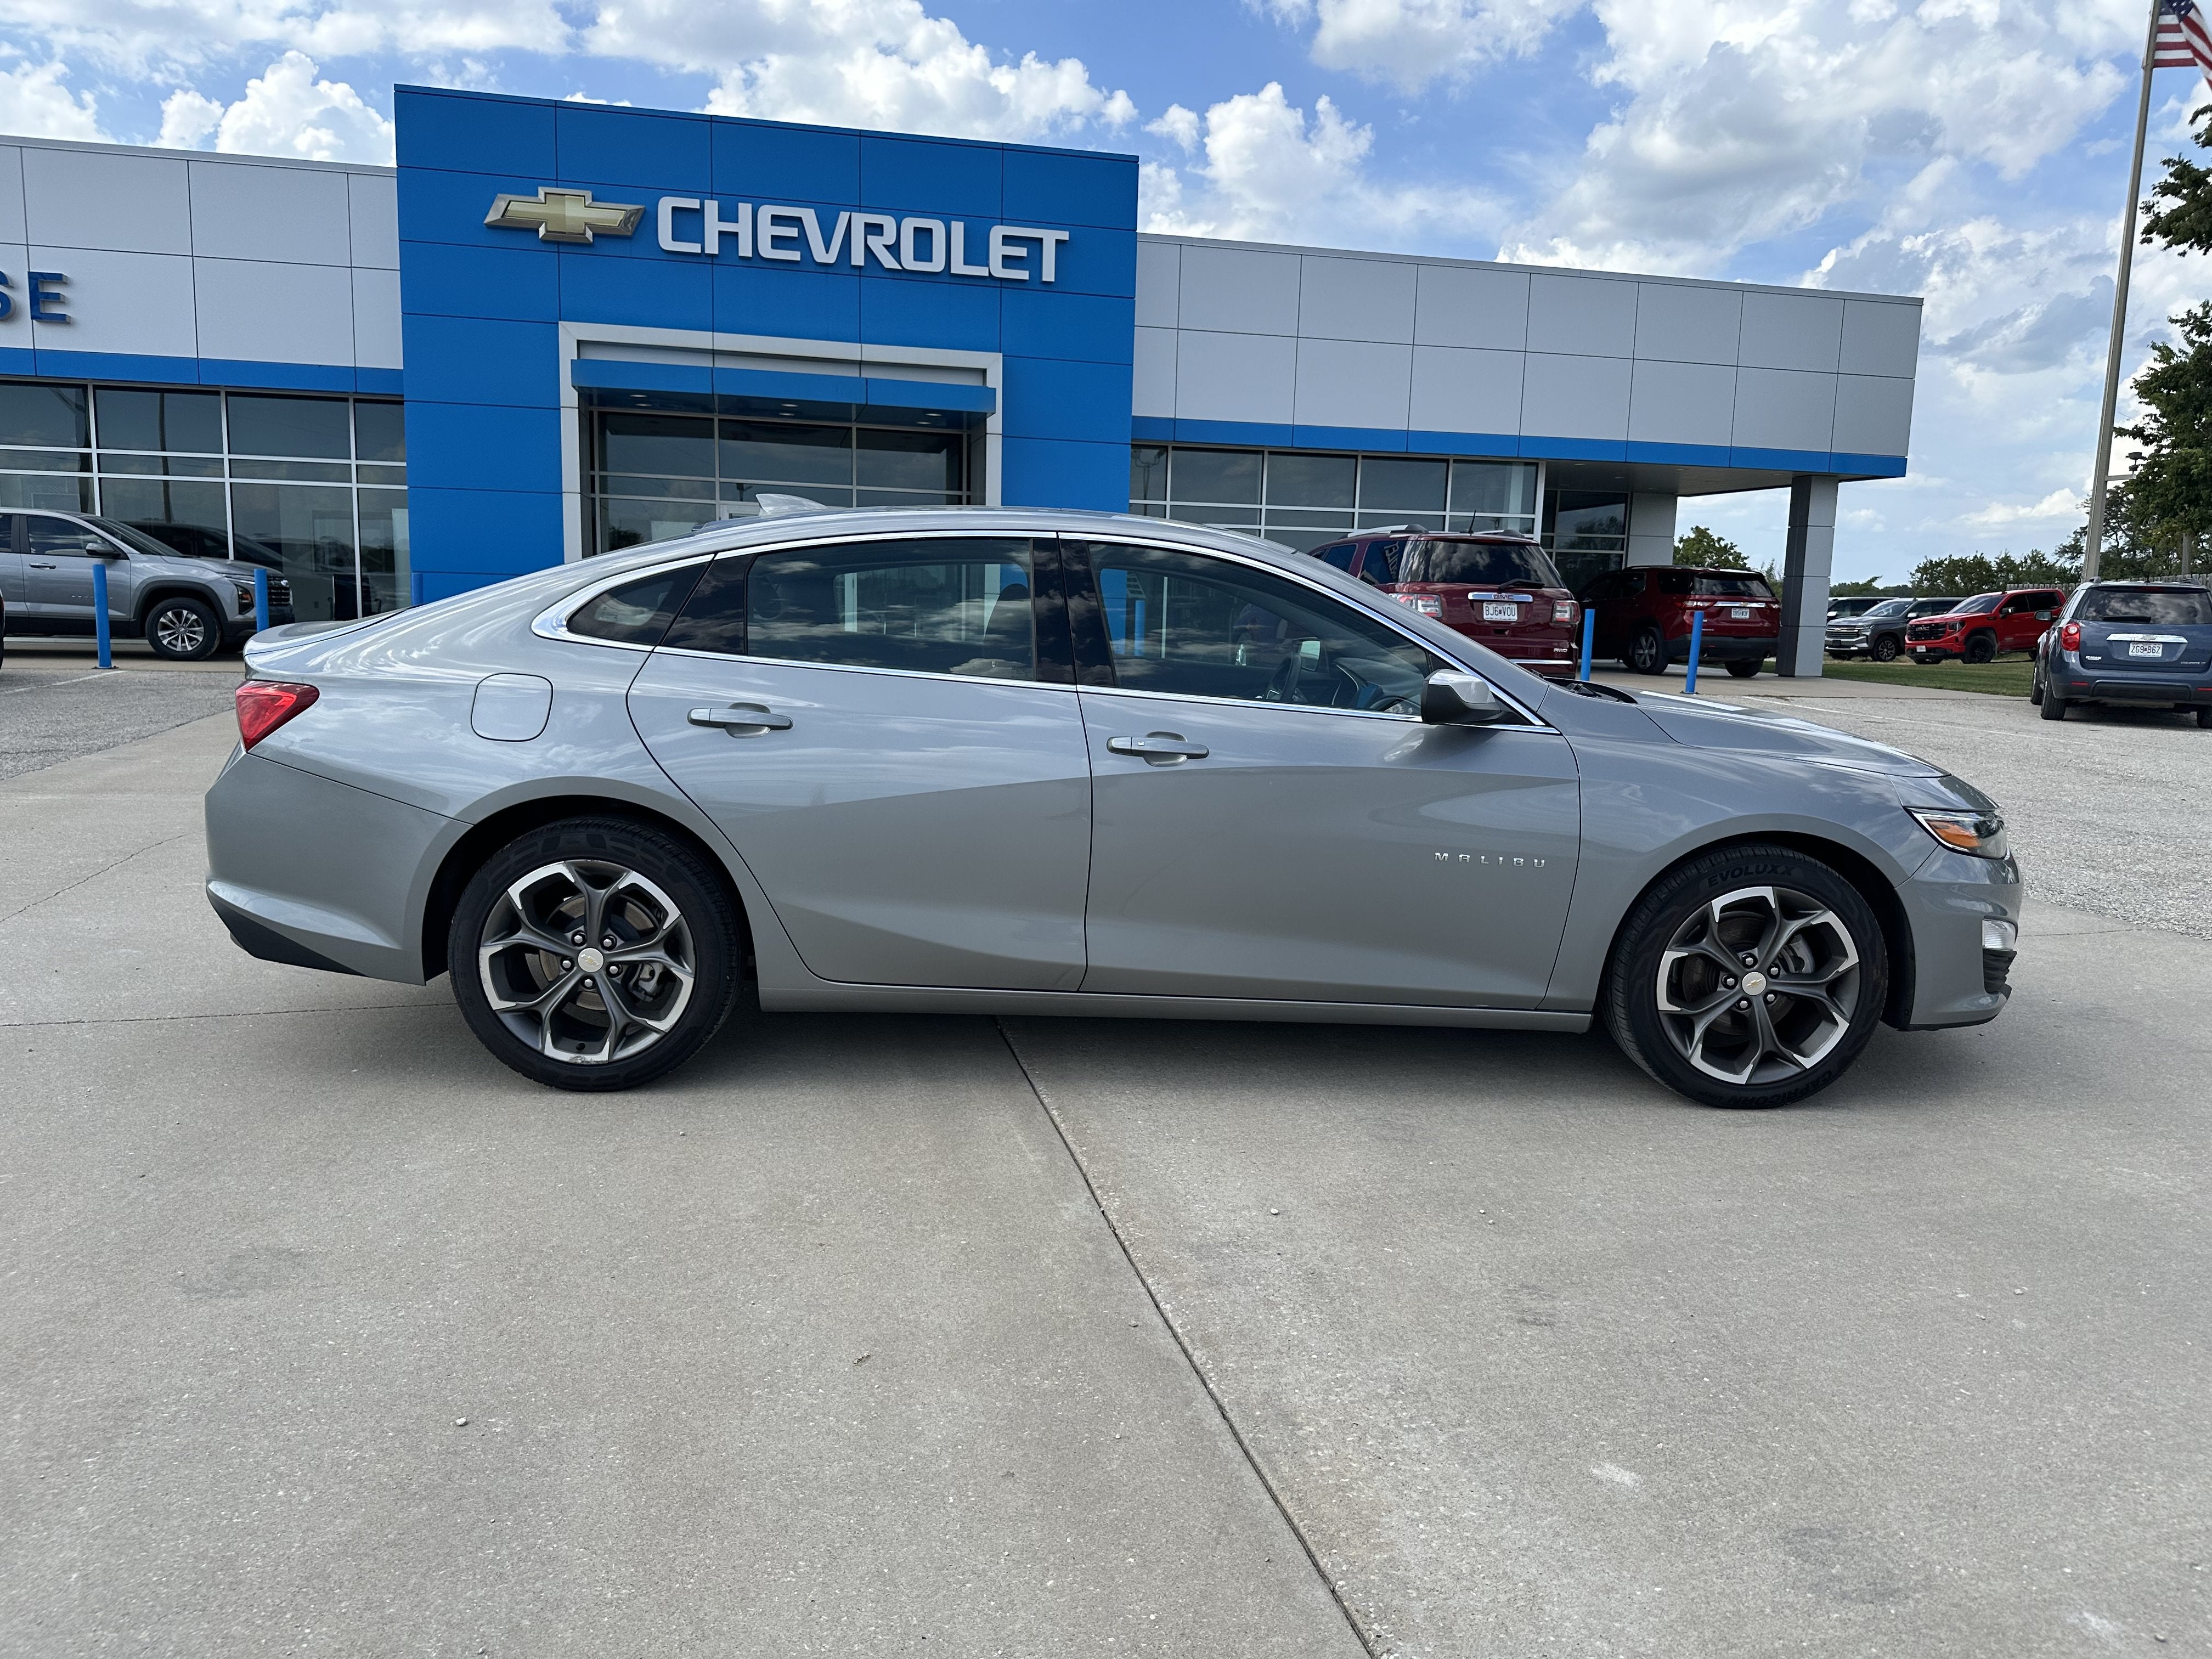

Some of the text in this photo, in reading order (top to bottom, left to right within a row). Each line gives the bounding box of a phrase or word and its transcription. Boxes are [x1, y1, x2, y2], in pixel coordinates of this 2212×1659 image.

[657, 195, 1070, 283] CHEVROLET
[1435, 852, 1545, 867] MALIBU
[1708, 864, 1795, 887] EVOLUXX
